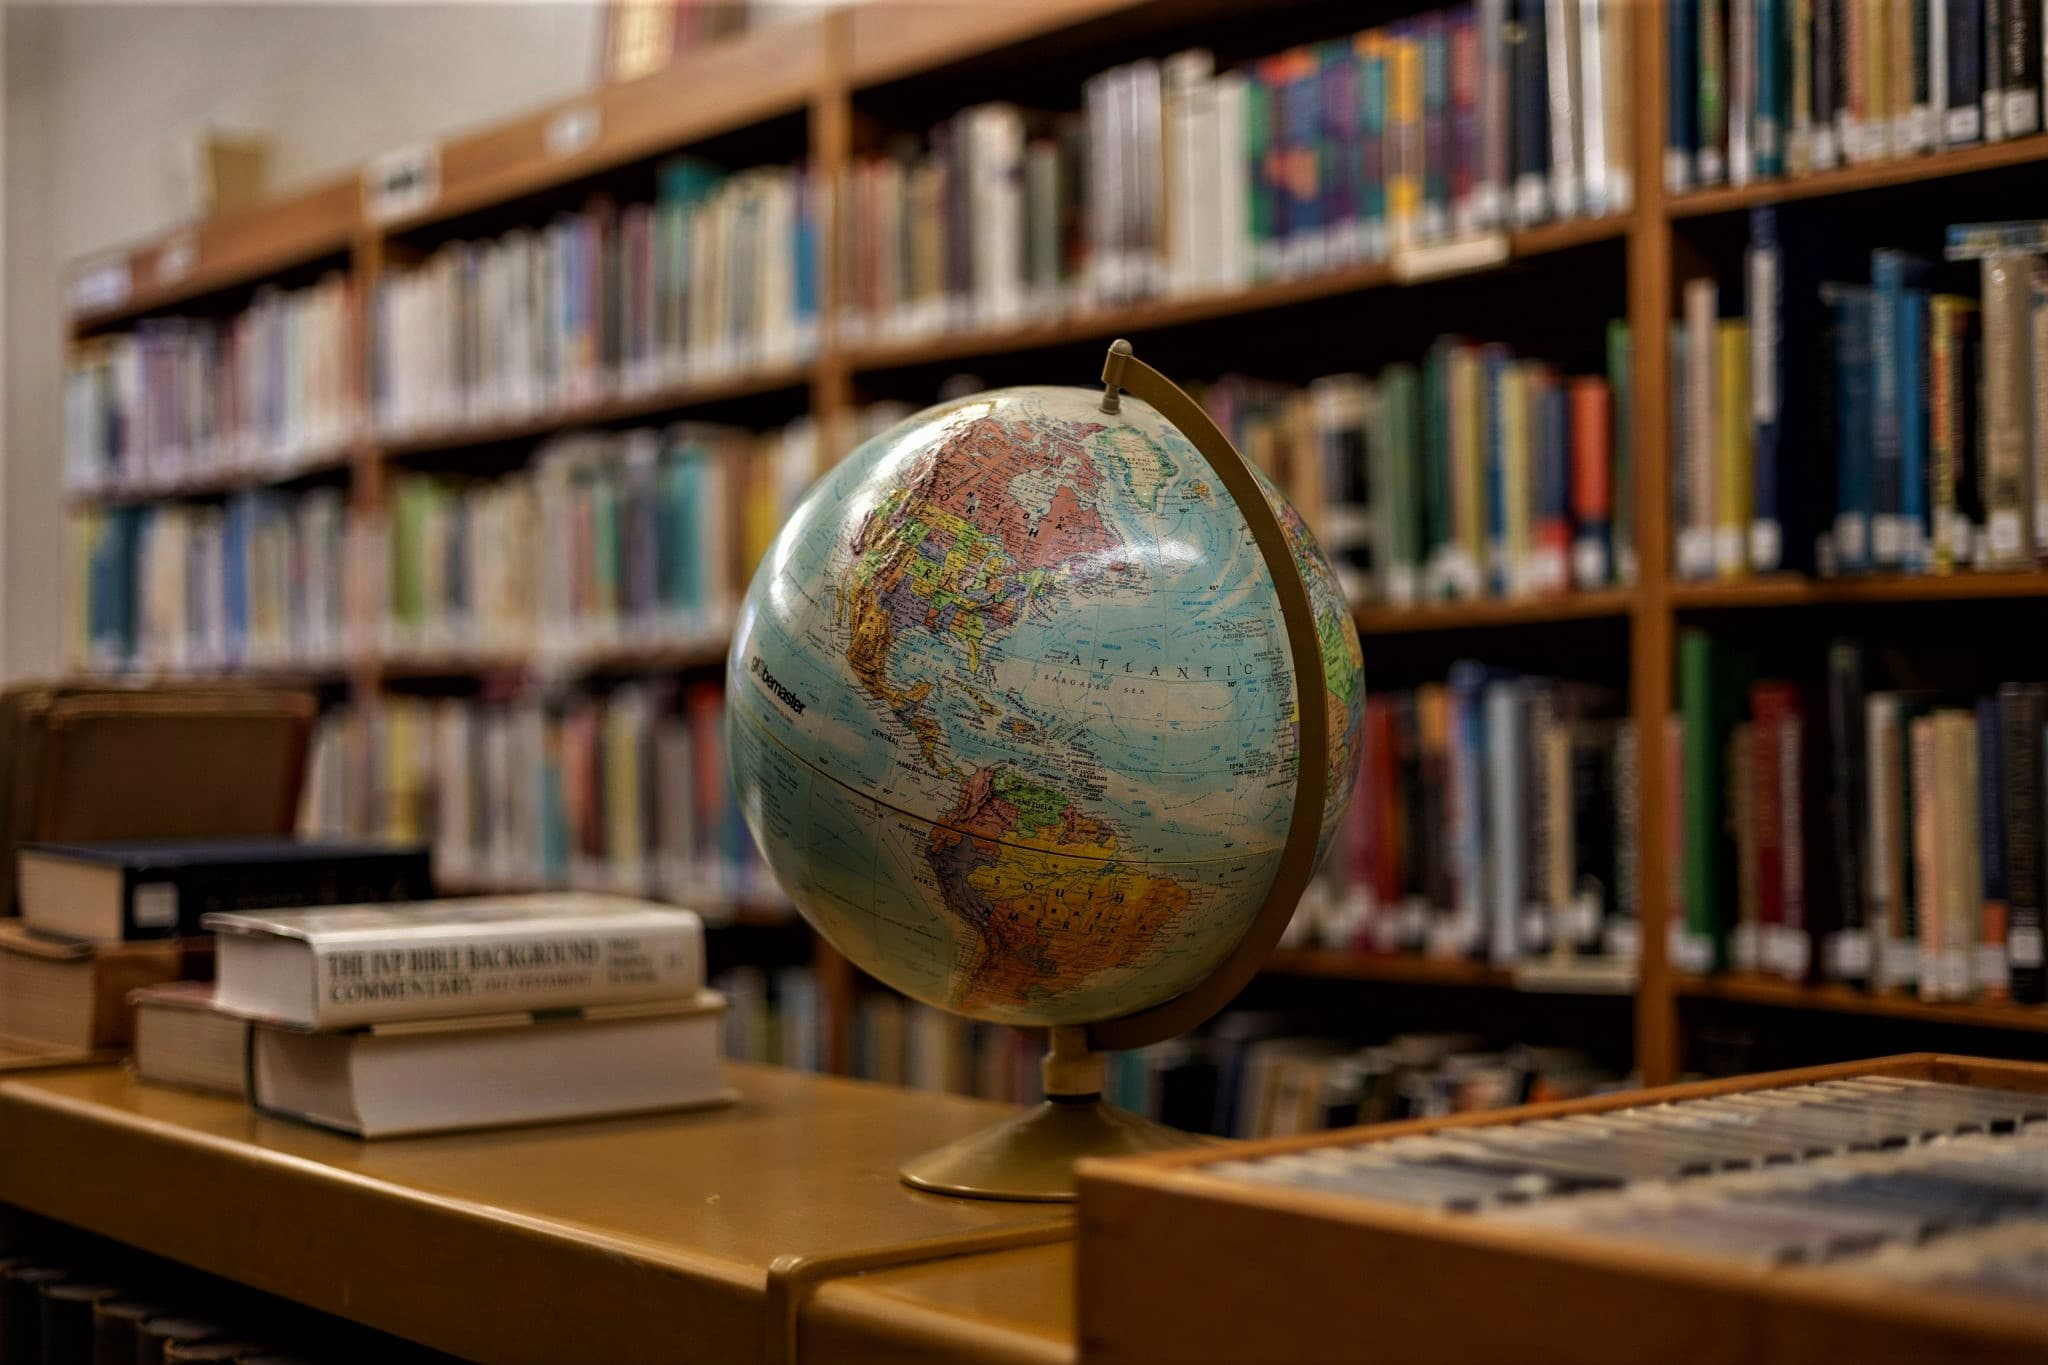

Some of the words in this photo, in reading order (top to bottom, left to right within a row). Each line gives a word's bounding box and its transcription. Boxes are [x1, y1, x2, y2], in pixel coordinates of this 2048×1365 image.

[910, 634, 936, 648] GULF
[903, 652, 950, 676] MEXICO
[1070, 652, 1253, 680] ATLANTIC
[1044, 673, 1109, 692] SARGASSO
[1123, 686, 1146, 696] SEA
[1005, 693, 1029, 713] BAHAMAS
[953, 712, 985, 725] JAMAICA
[871, 728, 900, 747] CENTRAL
[896, 759, 928, 776] AMERICA
[1013, 797, 1053, 812] VENEZUELA
[898, 822, 926, 838] ECUADOR
[913, 874, 935, 888] PERU
[994, 875, 1125, 904] SOUTH
[983, 907, 1147, 932] AMERICA
[1028, 904, 1144, 922] BRAZIL
[328, 953, 364, 978] THE
[407, 945, 461, 974] BIBLE
[469, 938, 599, 970] BACKGROUND
[329, 974, 473, 1005] COMMENTARY
